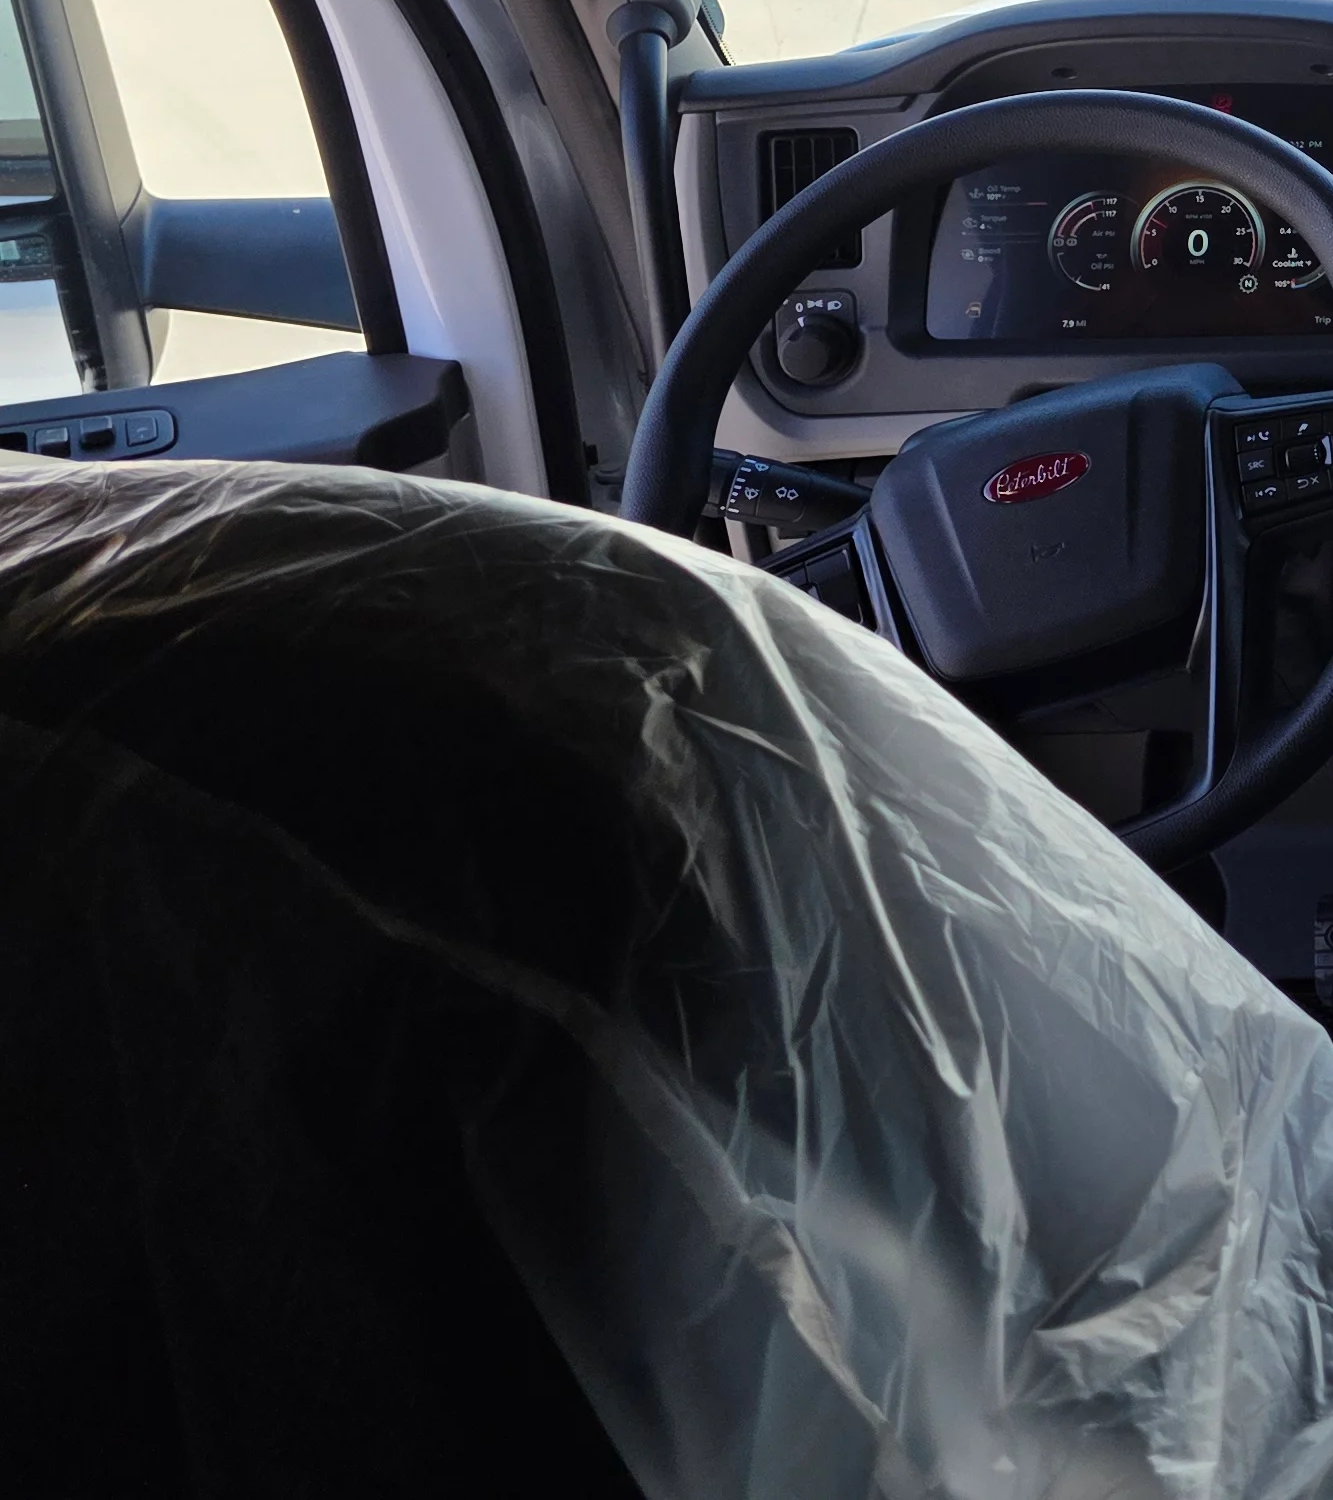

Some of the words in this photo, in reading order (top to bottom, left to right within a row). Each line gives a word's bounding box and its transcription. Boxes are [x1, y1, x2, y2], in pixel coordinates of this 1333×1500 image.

[1000, 185, 1021, 193] Temp
[1196, 195, 1205, 203] 15
[1188, 229, 1209, 257] 0
[1272, 260, 1303, 268] Coolant
[1062, 320, 1075, 328] 7.9
[1315, 316, 1331, 325] Trip
[1247, 459, 1265, 471] SRC
[997, 456, 1076, 498] Peterbilt
